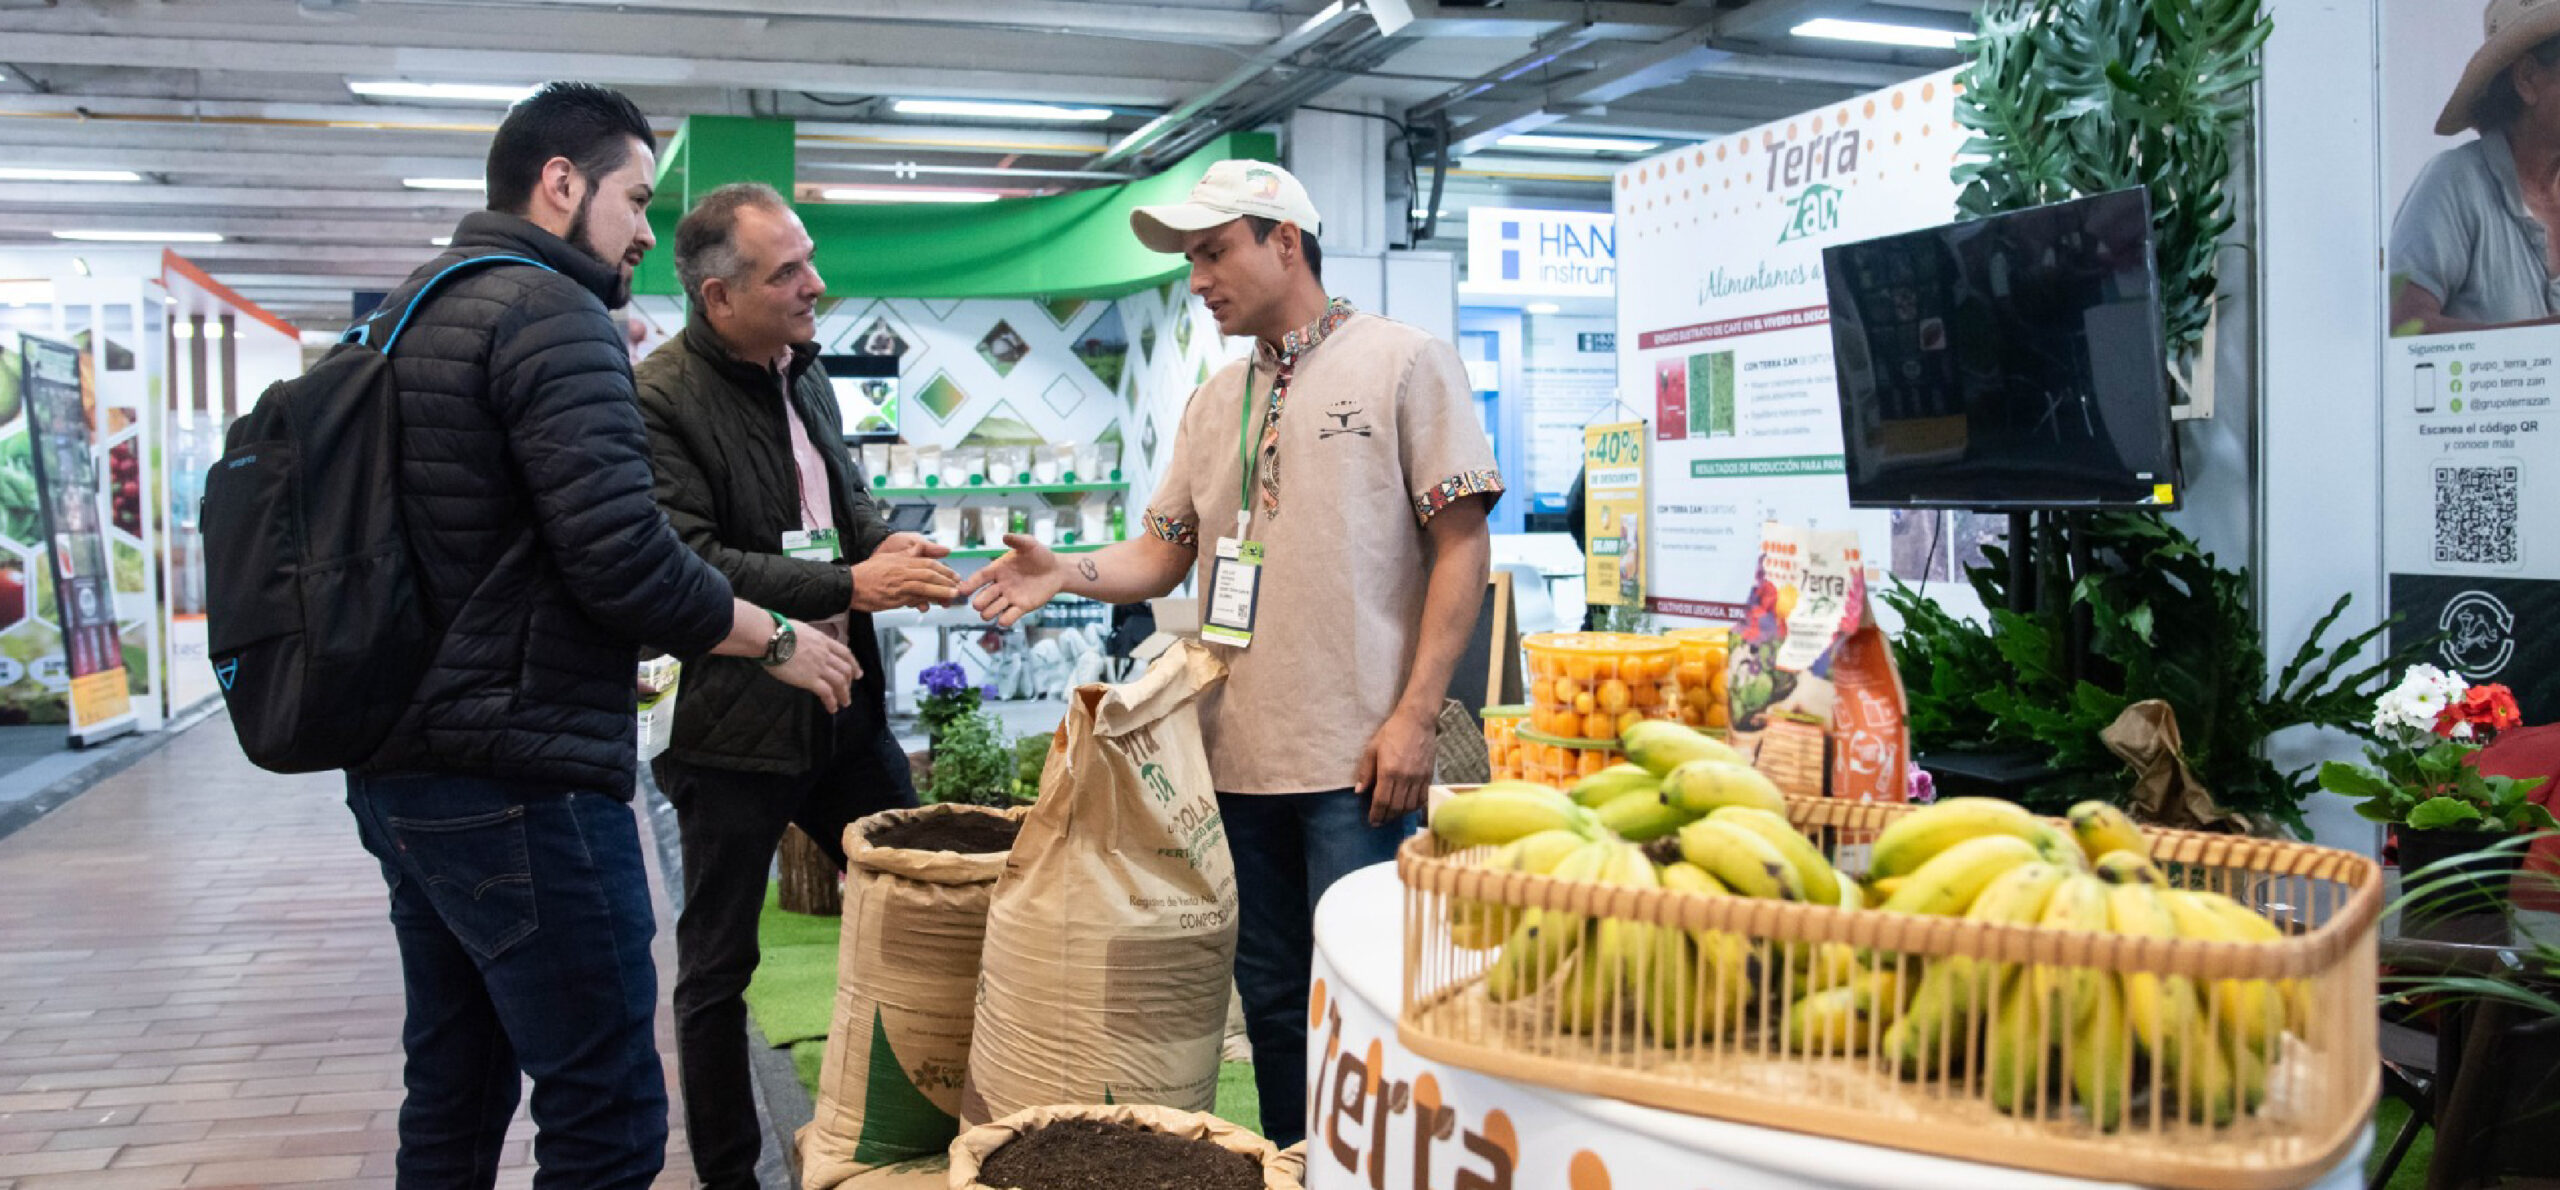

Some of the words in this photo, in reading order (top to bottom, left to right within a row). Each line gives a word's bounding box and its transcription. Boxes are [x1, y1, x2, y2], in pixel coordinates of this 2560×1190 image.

[1766, 129, 1859, 192] Terra
[2408, 343, 2456, 357] Síguenos
[2458, 342, 2475, 351] en:
[2469, 358, 2551, 373] grupo_terra_zan
[2469, 379, 2498, 392] grupo
[2500, 378, 2523, 388] terra
[2526, 377, 2546, 387] zan
[2470, 397, 2551, 412] @grupoterrazan
[2420, 424, 2463, 435] Escanea
[2466, 422, 2476, 433] el
[2480, 421, 2518, 435] código
[2520, 420, 2539, 432] QR
[1589, 430, 1639, 464] -40%
[2444, 442, 2450, 452] y
[2453, 441, 2489, 450] conoce
[2492, 438, 2515, 449] más
[1750, 458, 1800, 473] PRODUCCIÓN
[1801, 459, 1822, 471] PARA
[1801, 568, 1844, 597] Terra
